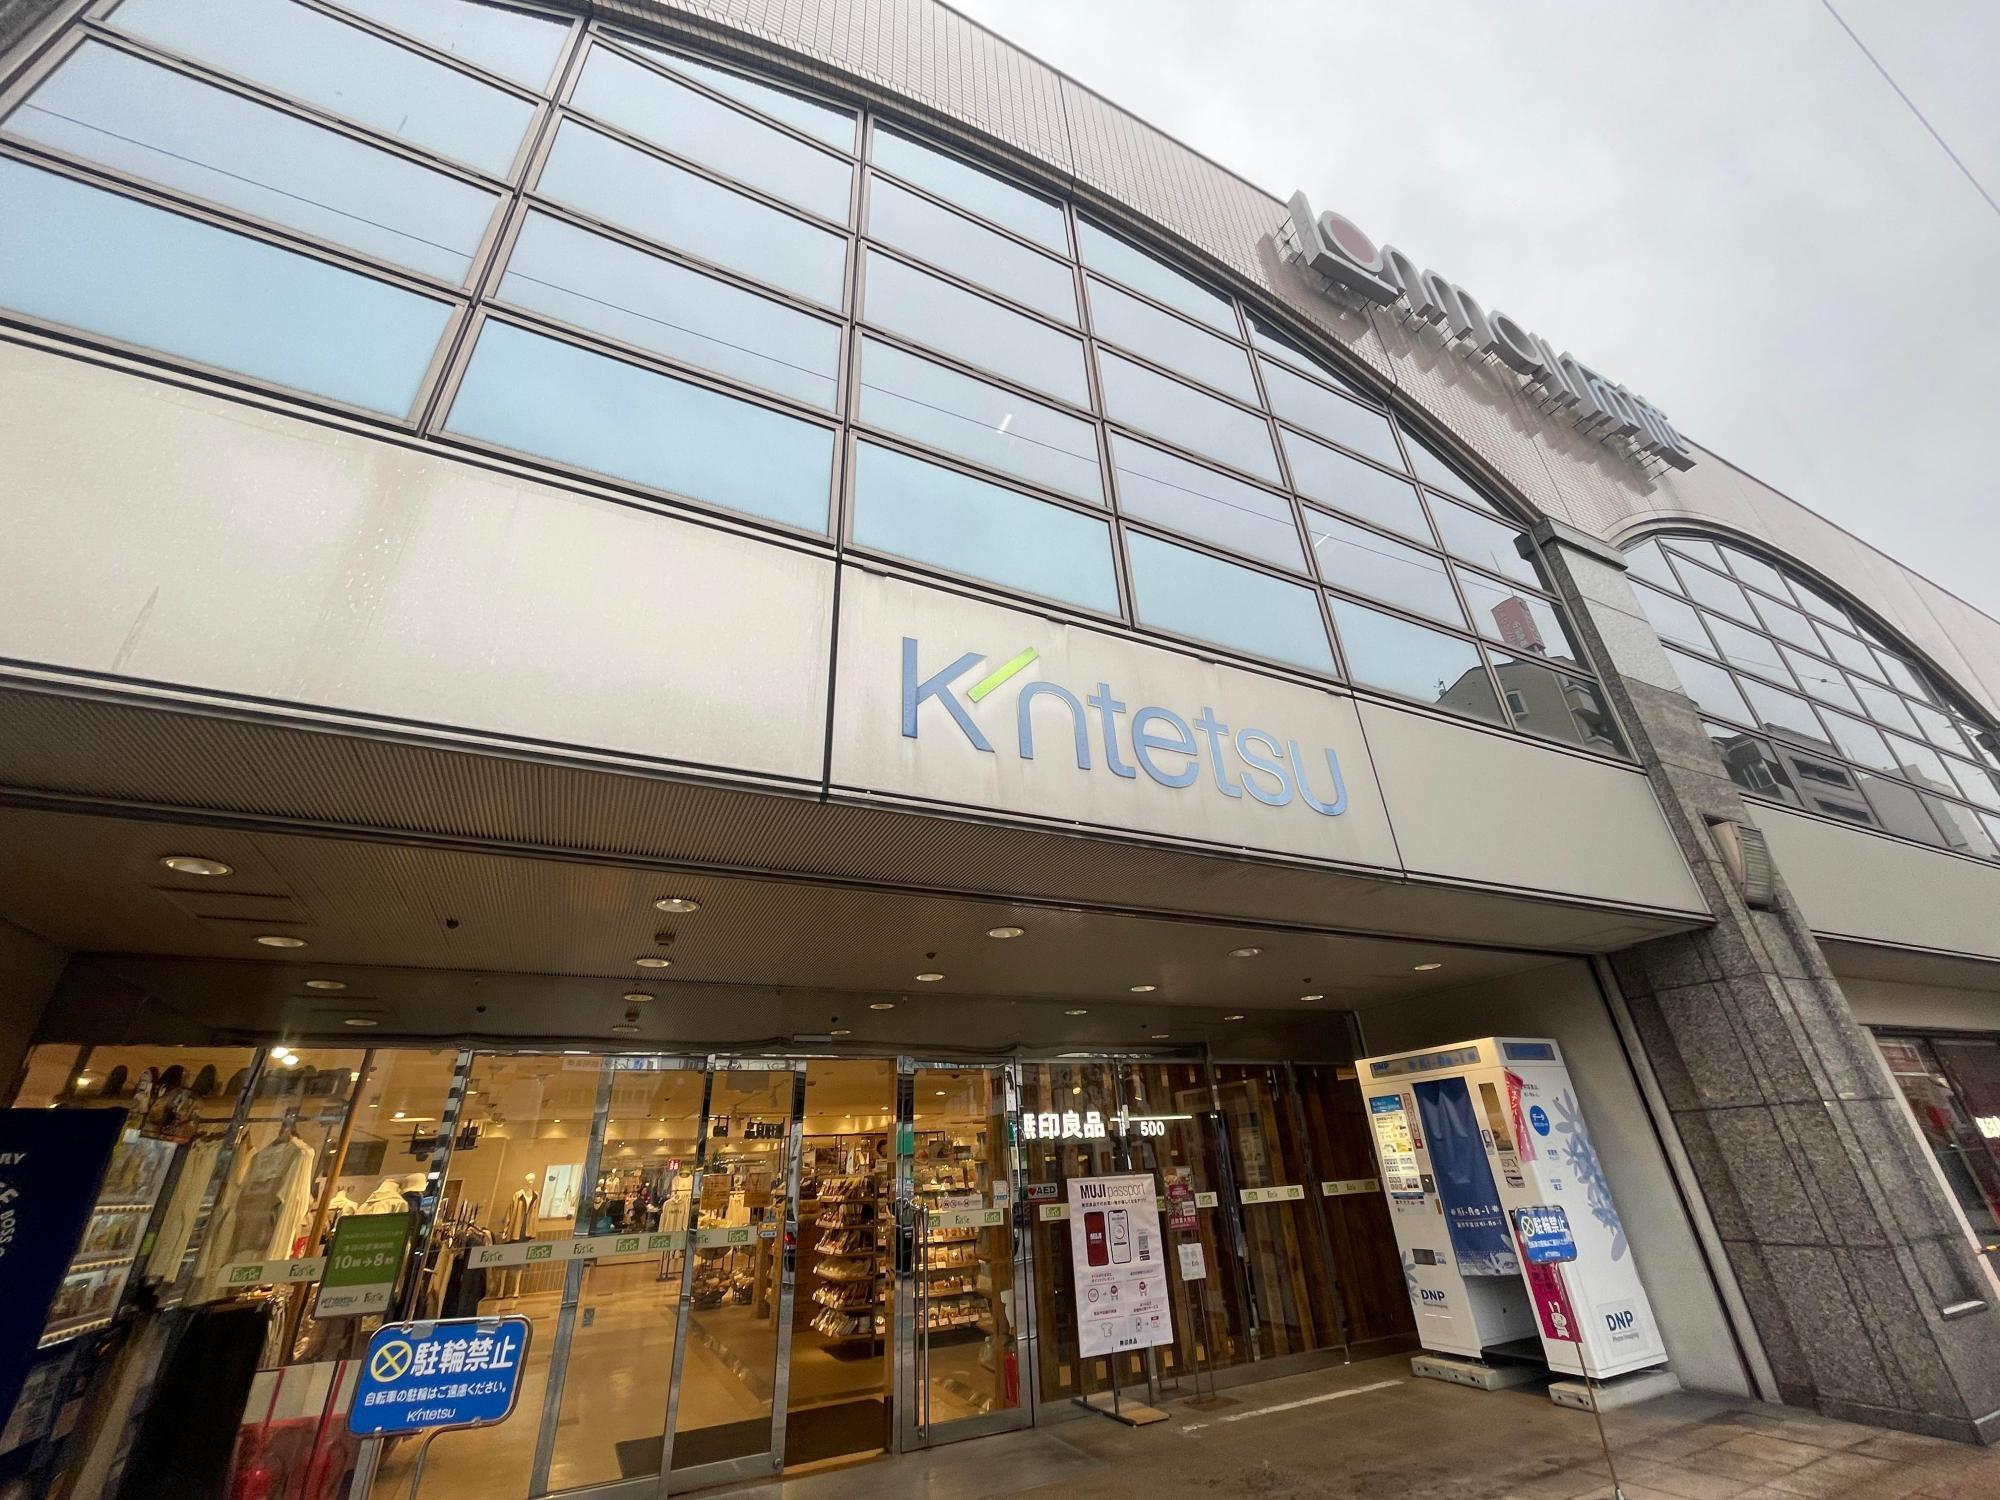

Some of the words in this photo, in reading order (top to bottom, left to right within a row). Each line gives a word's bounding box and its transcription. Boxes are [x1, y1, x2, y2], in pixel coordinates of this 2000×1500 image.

[1141, 1121, 1165, 1136] 500
[1037, 1186, 1056, 1194] AED
[1080, 1184, 1106, 1199] MUJI
[1107, 1183, 1146, 1199] passport
[1421, 1289, 1445, 1301] DNP
[1606, 1311, 1634, 1331] DNP
[410, 1336, 516, 1377] 駐輪禁止
[364, 1380, 507, 1406] 自転車の駐輪はご遠慮ください。
